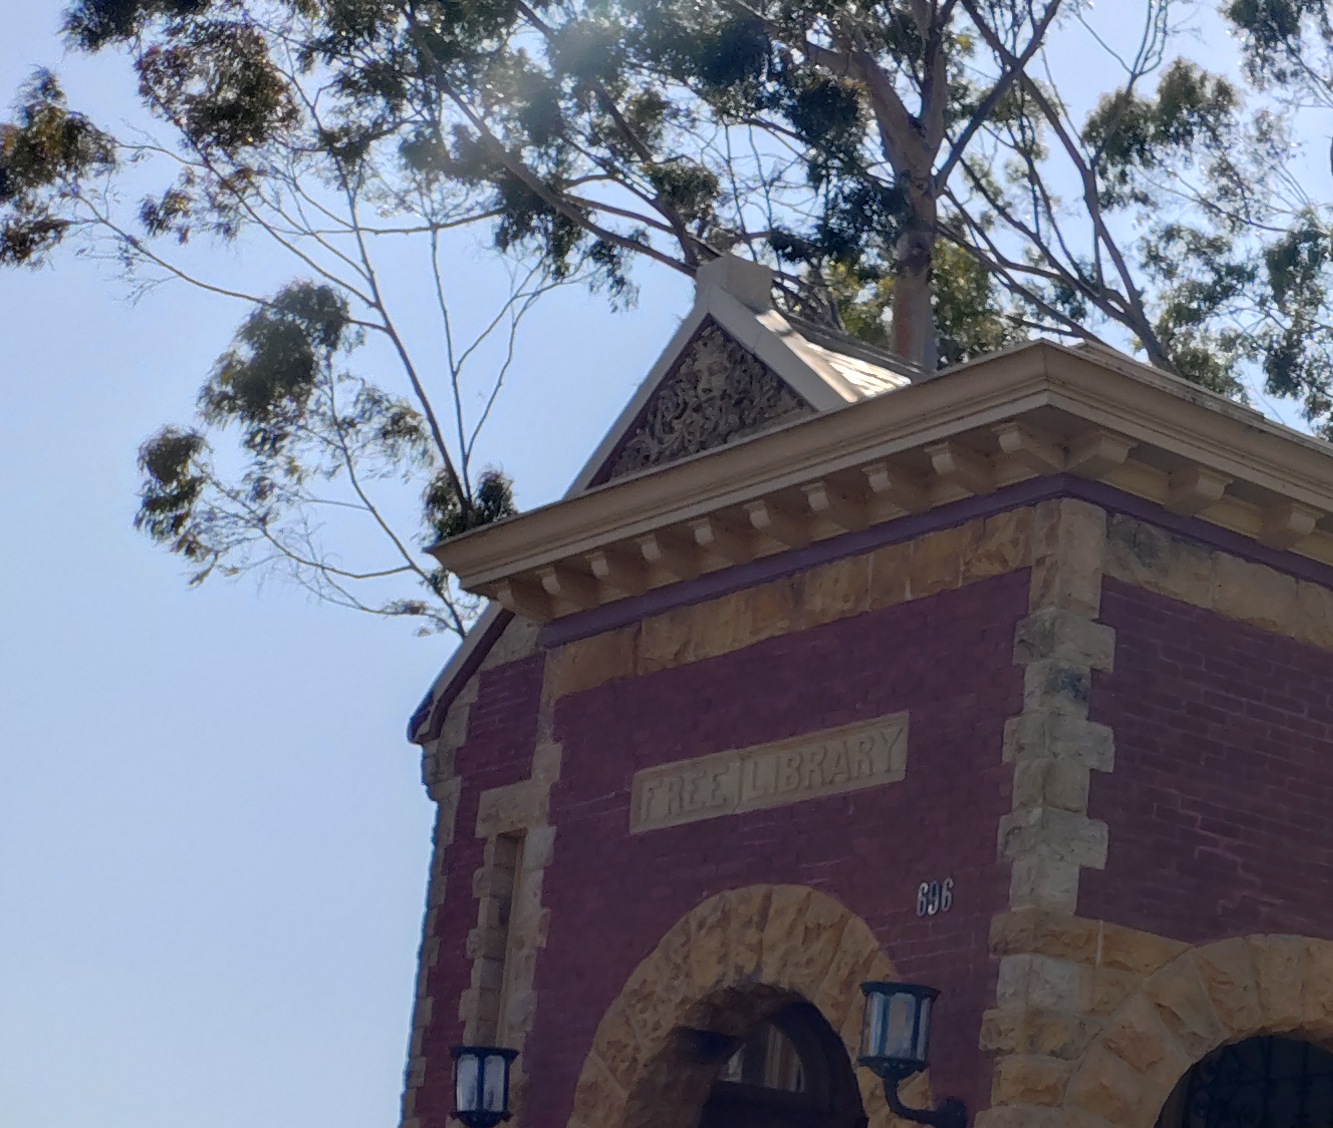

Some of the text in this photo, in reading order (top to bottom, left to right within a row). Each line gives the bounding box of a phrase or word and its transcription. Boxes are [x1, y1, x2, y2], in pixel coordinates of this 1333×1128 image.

[640, 726, 904, 822] FREE LIBRARY
[916, 876, 954, 917] 696
